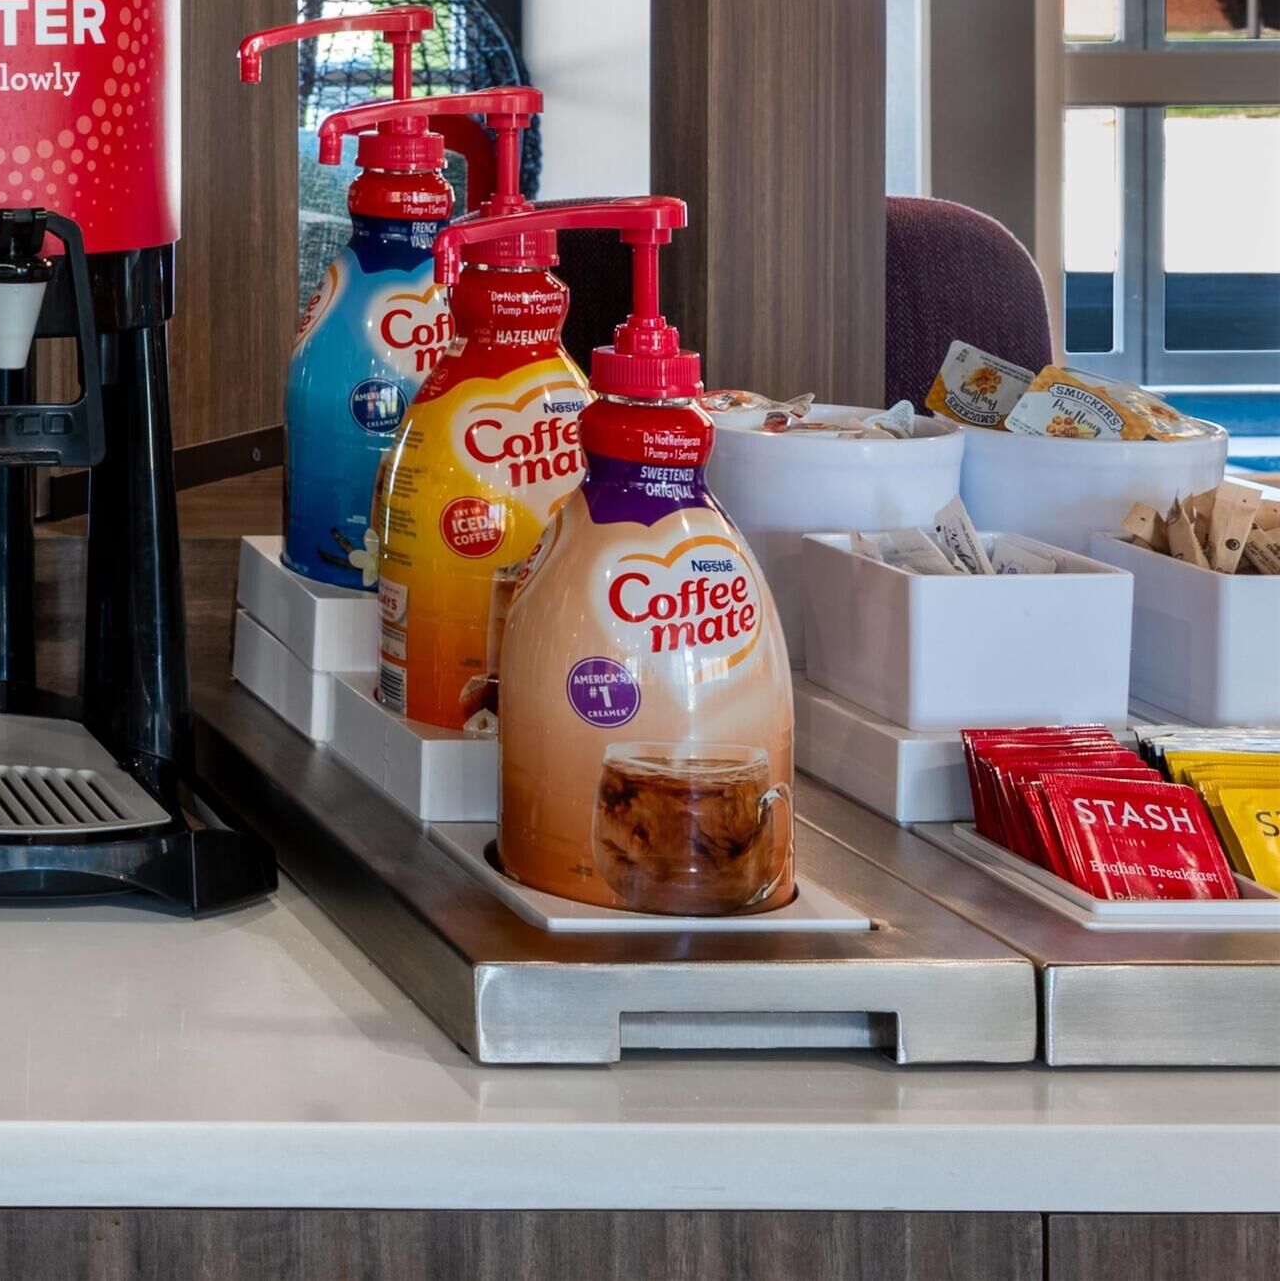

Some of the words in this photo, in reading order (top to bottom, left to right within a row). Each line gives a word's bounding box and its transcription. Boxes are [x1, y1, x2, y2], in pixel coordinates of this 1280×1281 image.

[411, 222, 438, 234] FRENCH
[491, 291, 502, 301] Do
[503, 292, 520, 302] Not
[492, 304, 496, 314] 1
[497, 304, 521, 317] Pump
[530, 304, 534, 314] 1
[536, 304, 562, 315] Serving
[381, 309, 454, 349] Coff
[496, 328, 555, 343] HAZELNUT
[1052, 398, 1073, 416] Pure
[1072, 409, 1102, 438] Honey
[464, 418, 579, 463] Coffe
[643, 432, 654, 444] Do
[655, 433, 668, 445] Not
[648, 447, 668, 461] Pump
[678, 449, 699, 462] Serving
[640, 466, 694, 481] SWEETENED
[646, 482, 695, 499] ORIGINAL
[452, 515, 490, 533] ICED
[453, 531, 496, 546] COFFEE
[691, 559, 733, 573] Nestlé
[609, 572, 749, 623] Coffee
[650, 601, 756, 653] mate
[574, 673, 627, 685] AMERICA'S
[589, 686, 612, 708] #1
[1073, 797, 1197, 834] STASH
[1089, 860, 1145, 878] English
[1148, 864, 1219, 883] Breakfast
